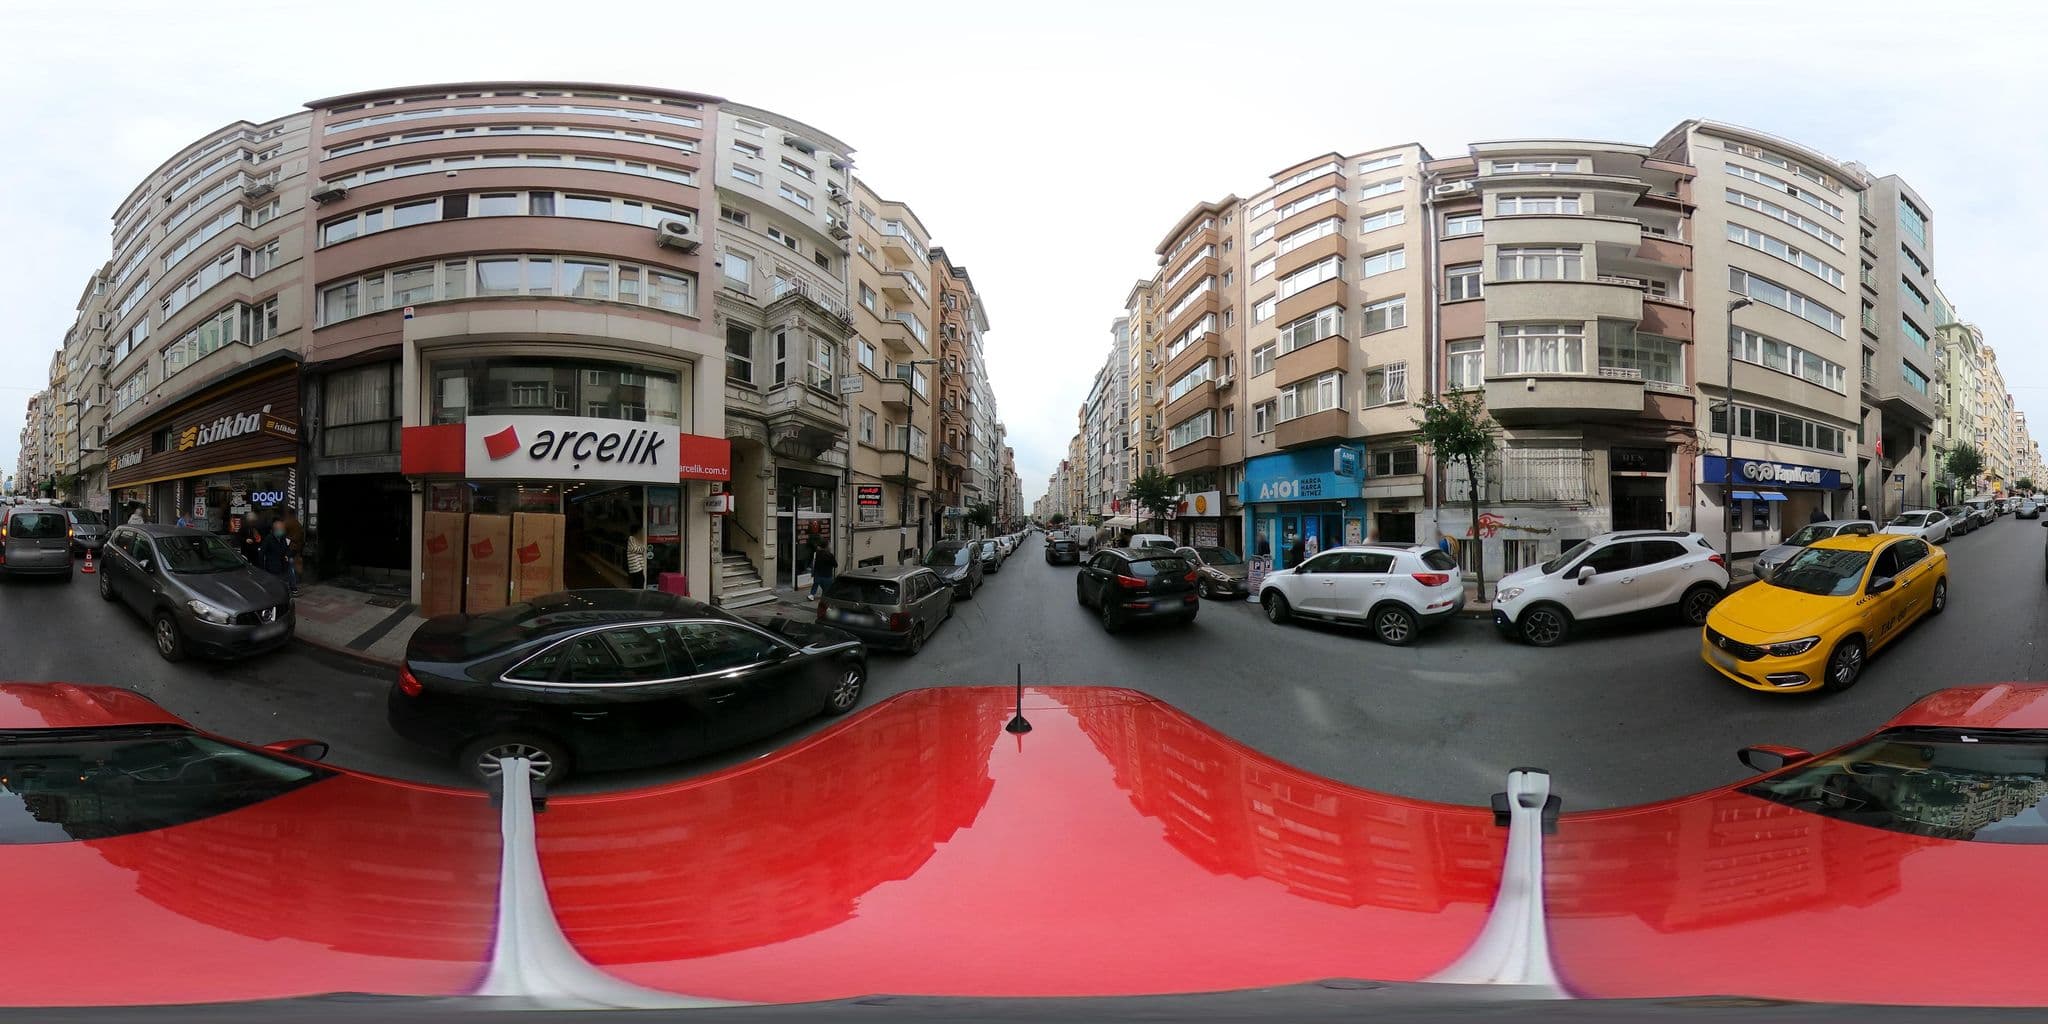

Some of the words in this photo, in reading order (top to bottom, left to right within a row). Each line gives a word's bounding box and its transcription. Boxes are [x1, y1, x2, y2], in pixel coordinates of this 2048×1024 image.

[117, 448, 144, 470] istikbal
[529, 426, 665, 470] arçelik
[252, 491, 284, 504] DOQU
